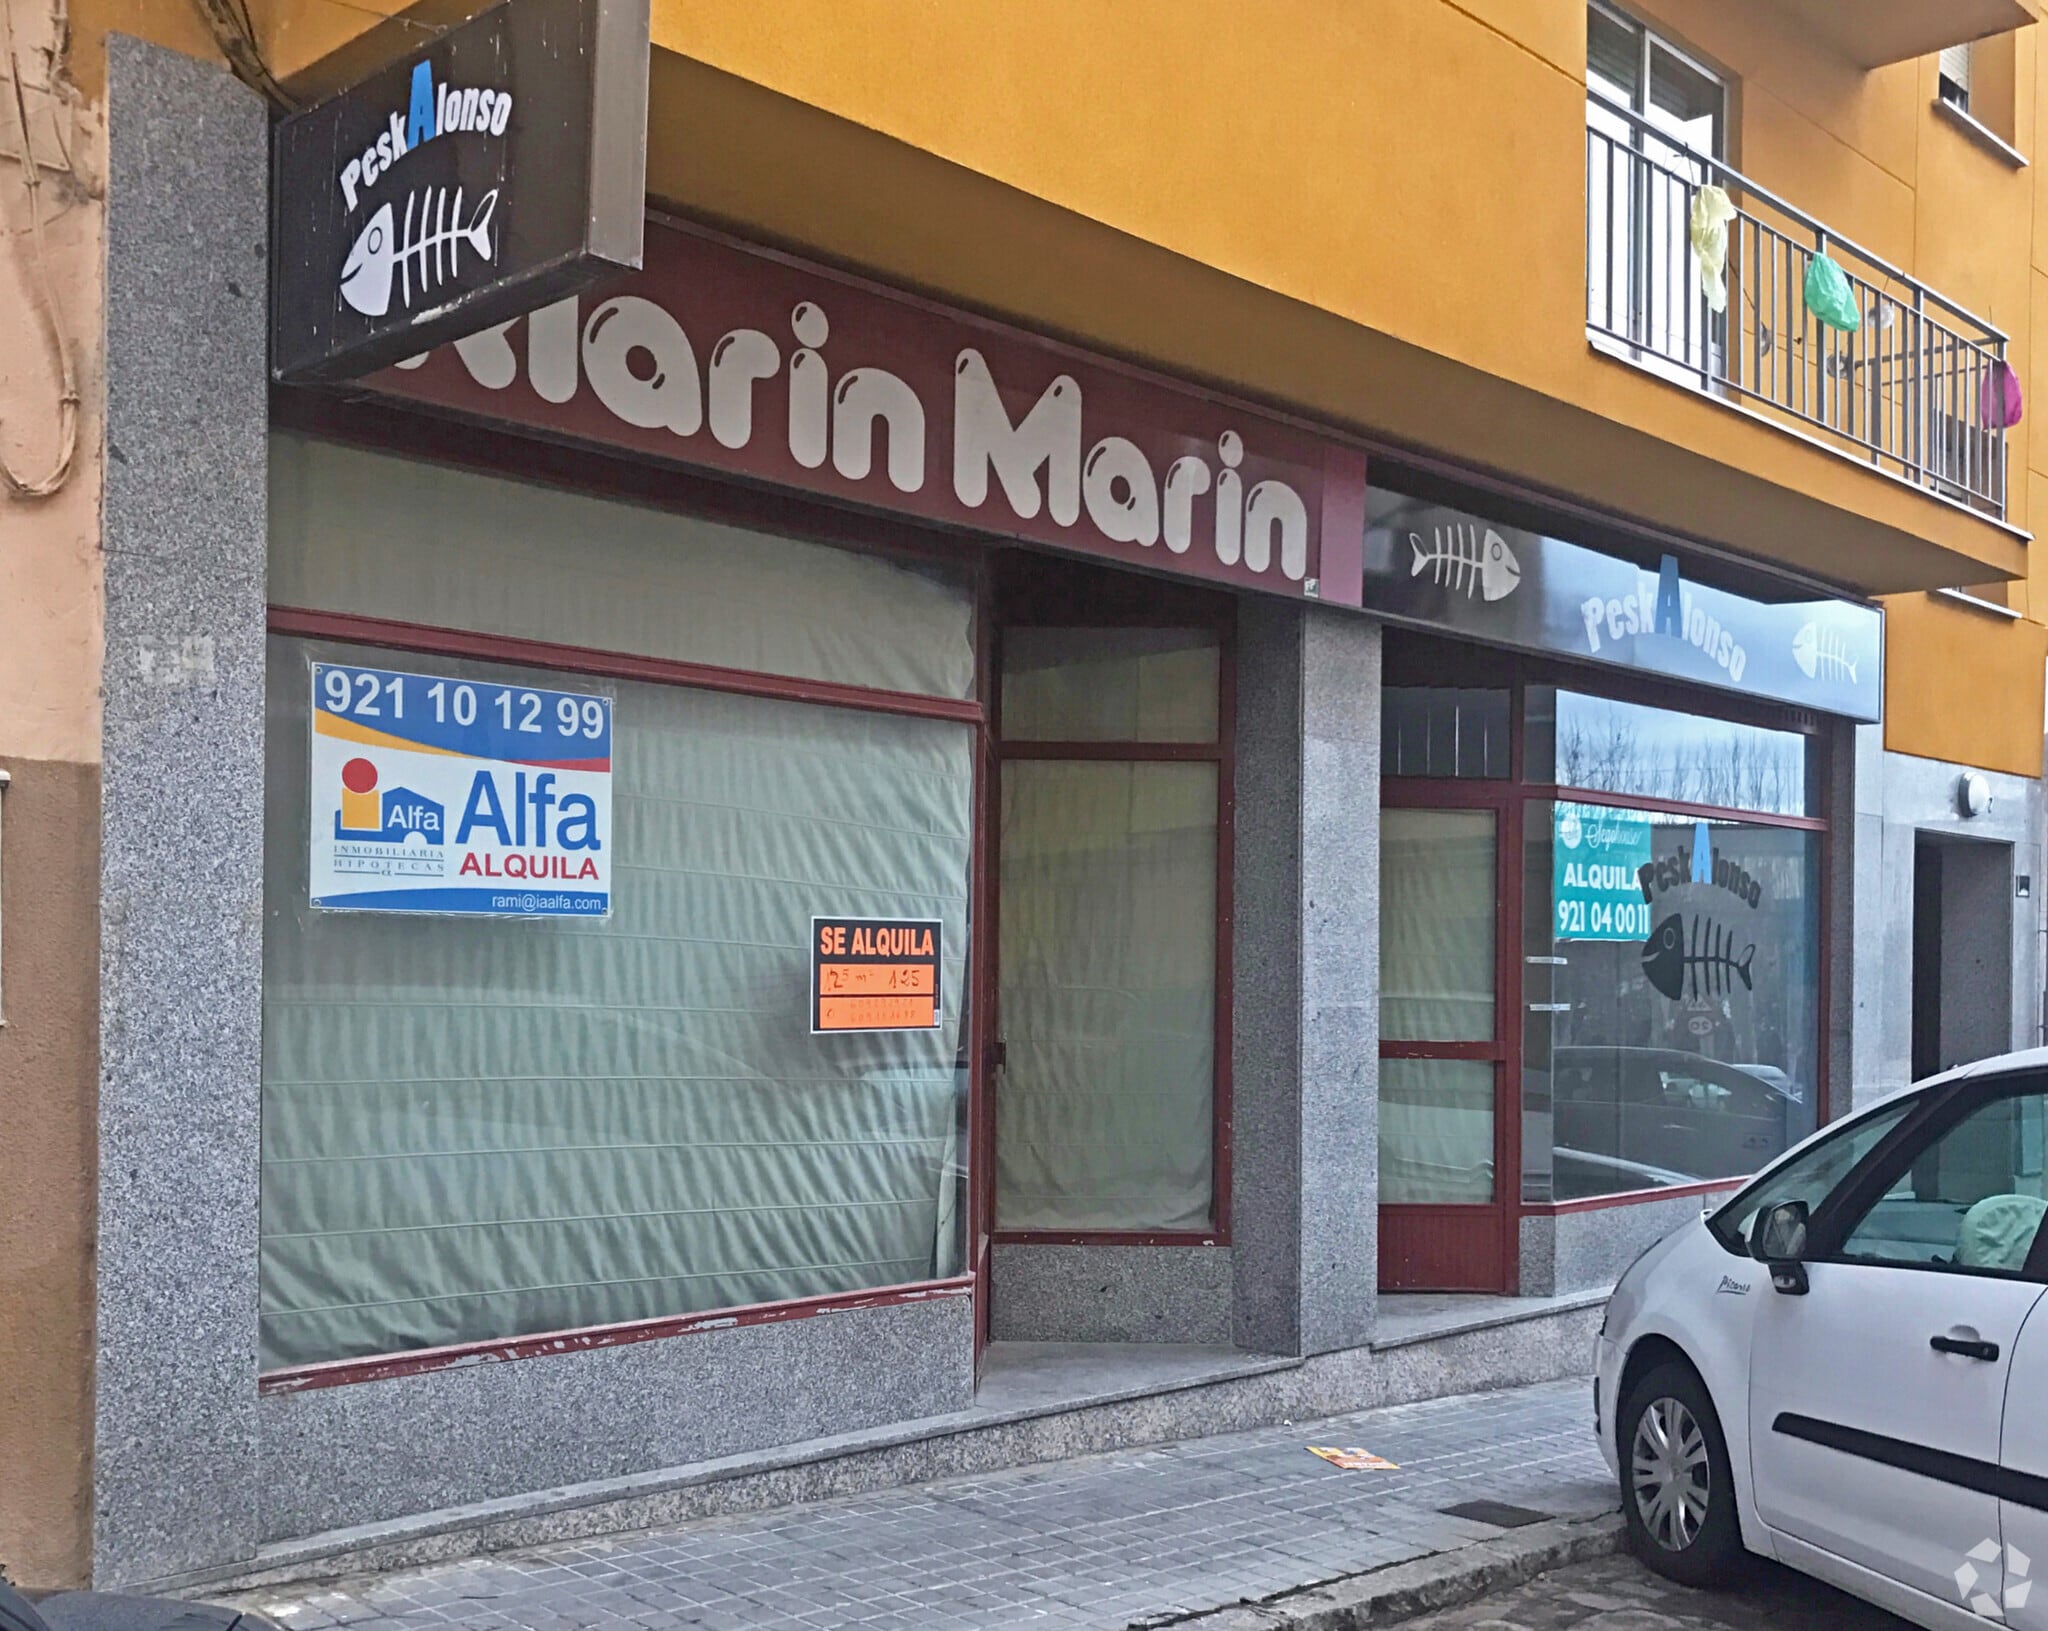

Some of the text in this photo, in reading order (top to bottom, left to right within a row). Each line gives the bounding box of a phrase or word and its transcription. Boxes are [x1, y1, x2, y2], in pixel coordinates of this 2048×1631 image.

[953, 348, 1308, 581] Marin
[324, 670, 604, 739] 921 10 12 99
[387, 804, 440, 831] Alfa
[455, 770, 601, 851] Alfa
[334, 844, 444, 859] INMOBILIARIA
[334, 859, 444, 872] HIPOTECAS
[459, 852, 600, 880] ALQUILA
[1563, 863, 1644, 890] ALQUILA
[491, 893, 601, 912] rami@iaalfa.com
[1558, 900, 1585, 931] 921
[820, 926, 935, 957] SE ALQUILA
